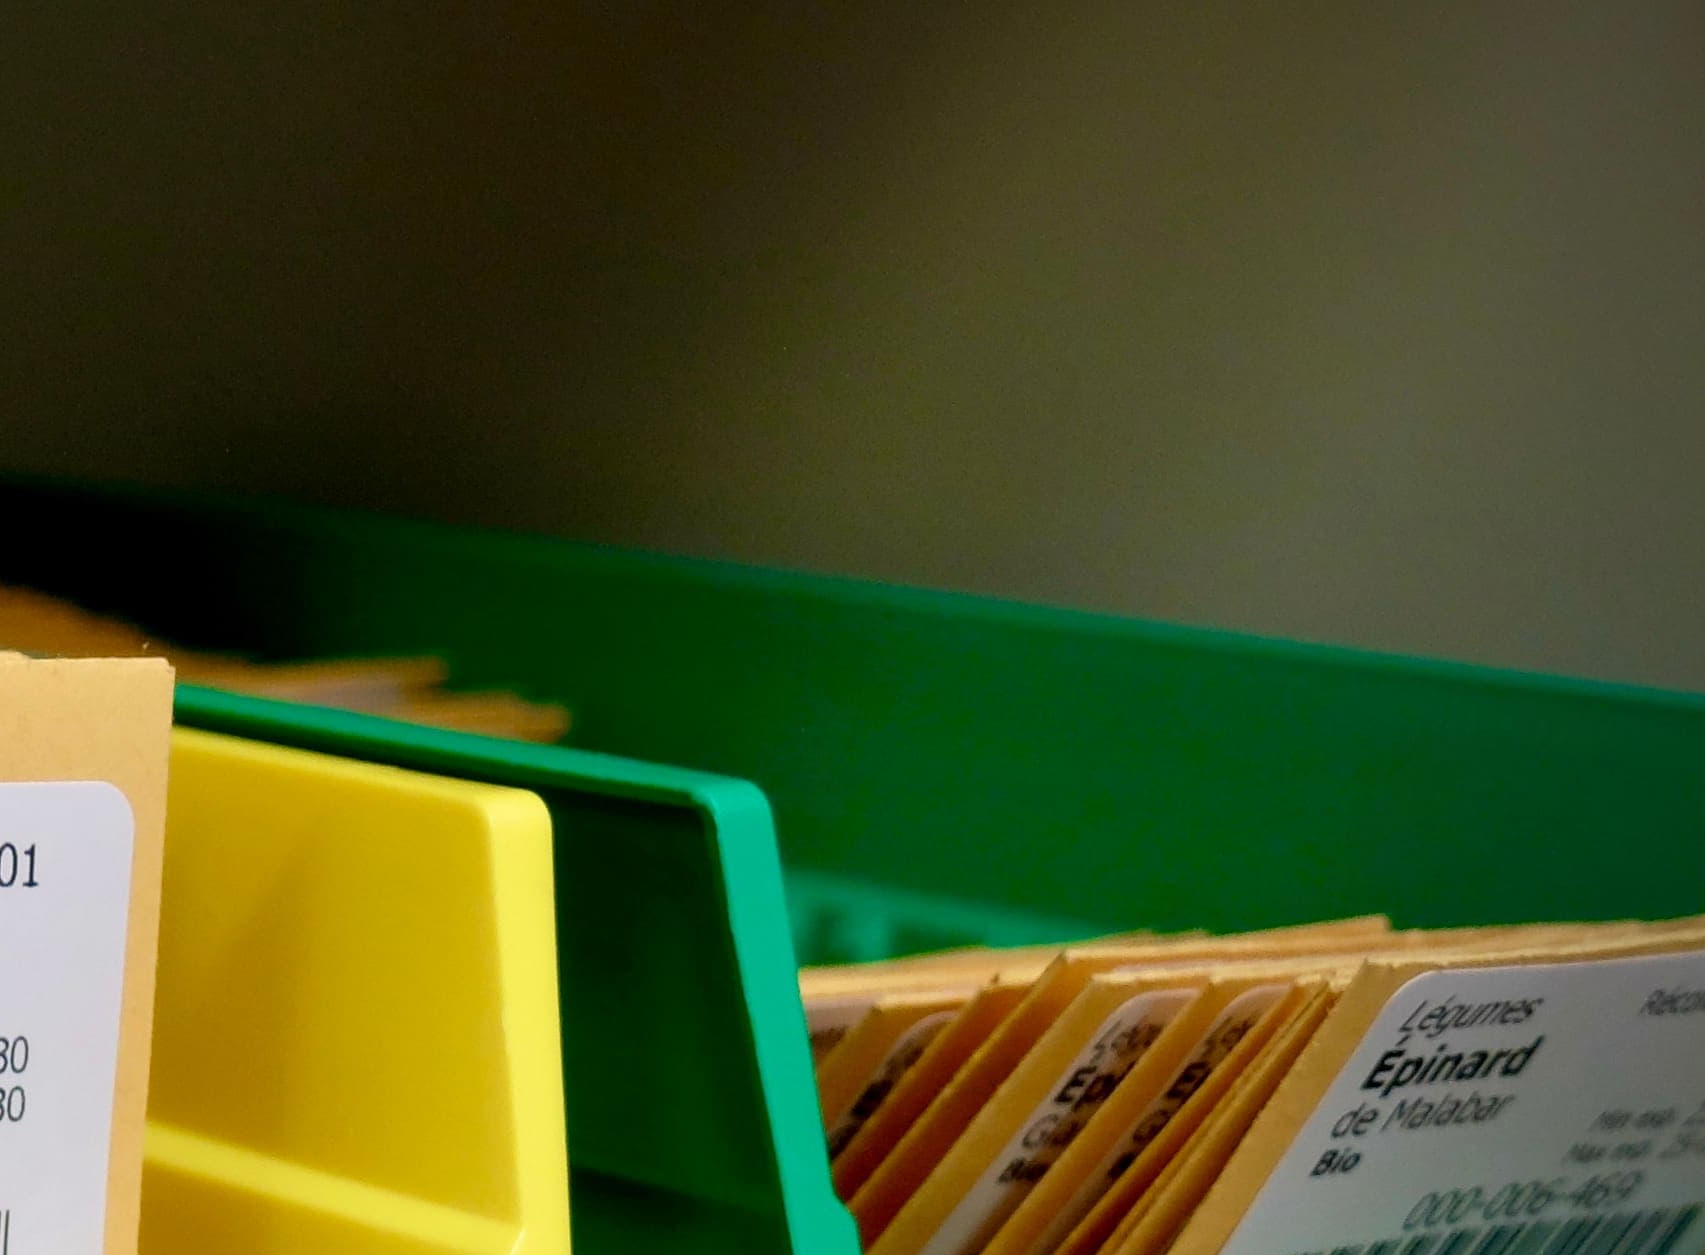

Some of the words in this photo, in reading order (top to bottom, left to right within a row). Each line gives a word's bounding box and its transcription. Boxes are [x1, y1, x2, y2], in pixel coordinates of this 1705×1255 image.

[1398, 994, 1545, 1039] Légumes
[1359, 1034, 1545, 1098] Épinard
[1331, 1101, 1378, 1138] de
[1379, 1091, 1517, 1133] Malabar
[1309, 1148, 1363, 1178] Bio
